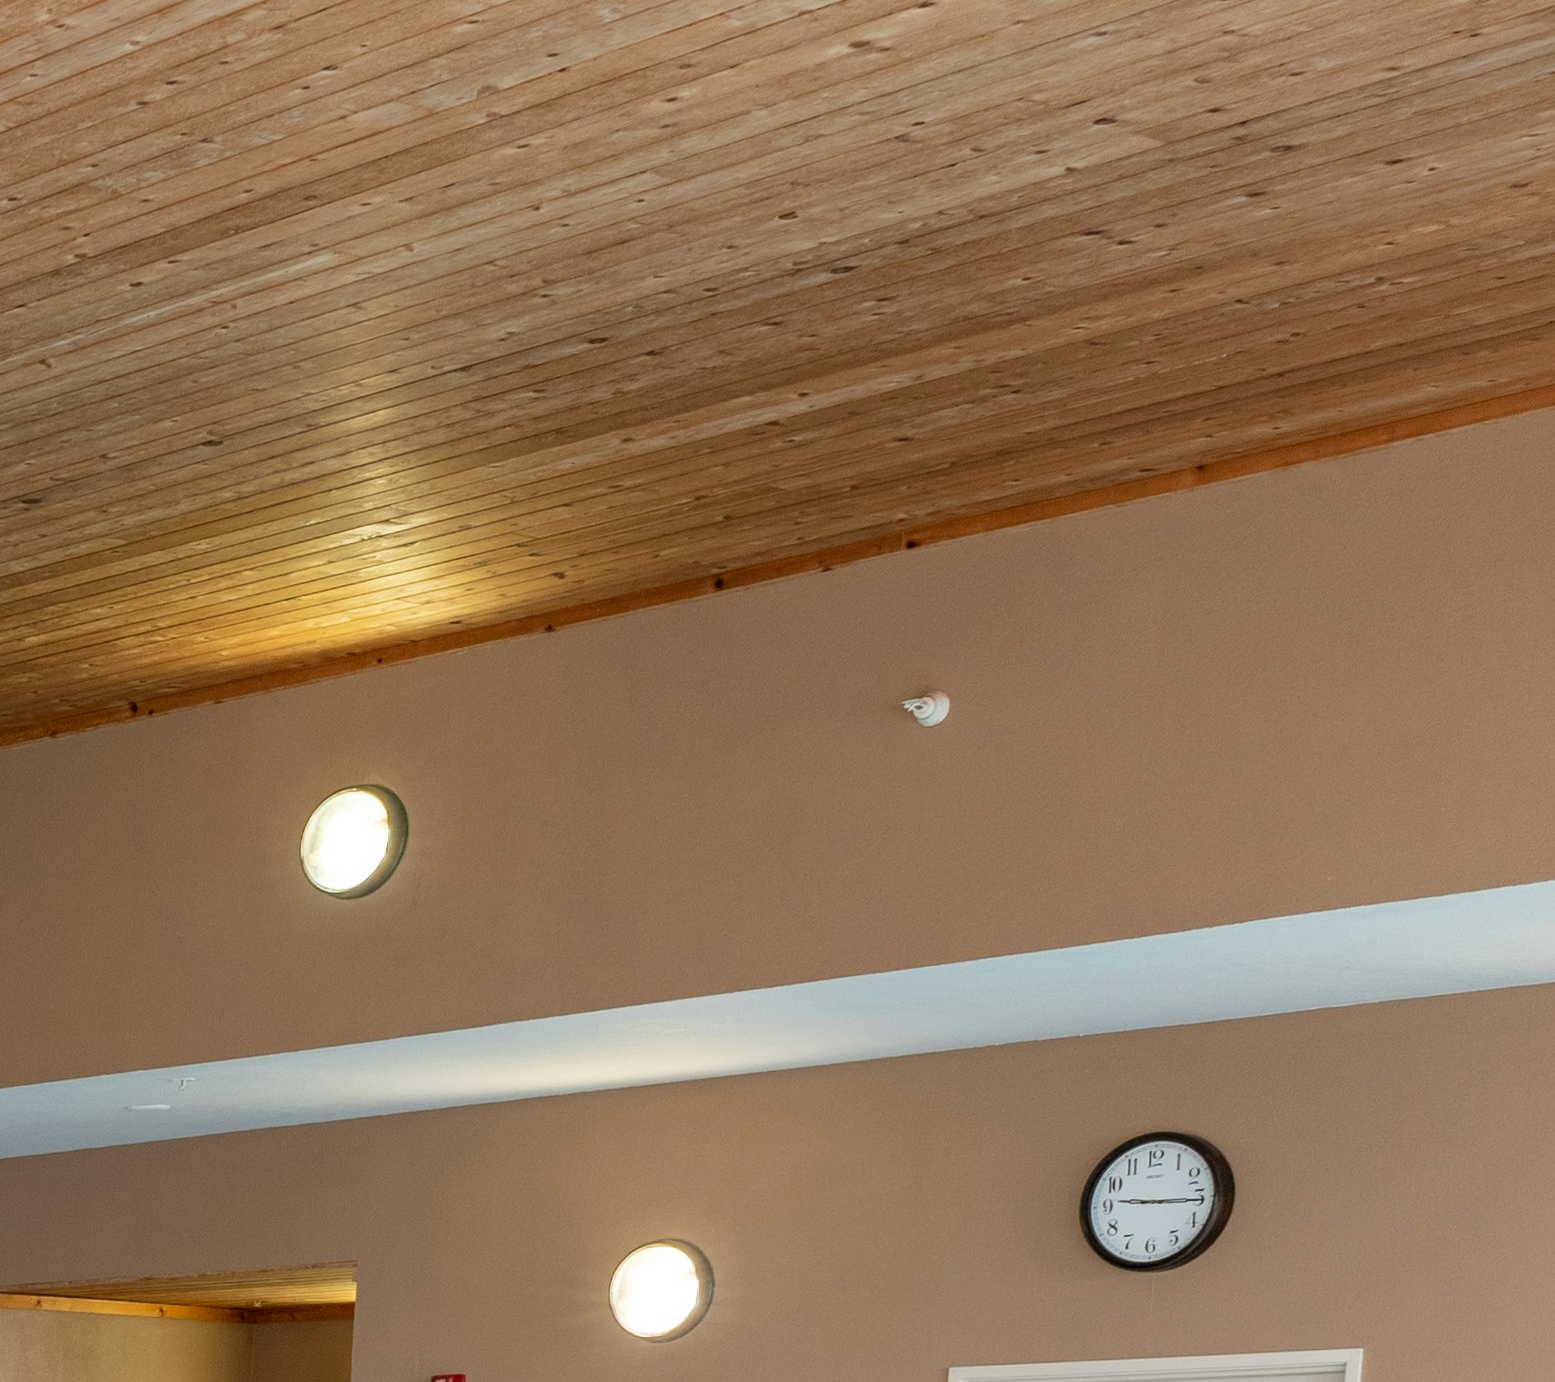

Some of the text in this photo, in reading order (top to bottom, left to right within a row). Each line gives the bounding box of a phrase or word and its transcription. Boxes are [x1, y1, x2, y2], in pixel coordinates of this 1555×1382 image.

[1126, 1158, 1138, 1176] 11
[1147, 1149, 1165, 1168] 12
[1175, 1153, 1182, 1171] 1
[1108, 1176, 1123, 1193] 10
[1187, 1167, 1201, 1185] 2
[1194, 1188, 1205, 1206] 3
[1102, 1198, 1113, 1215] 9
[1106, 1219, 1118, 1236] 8
[1184, 1211, 1199, 1228] 4
[1123, 1233, 1134, 1250] 7
[1144, 1237, 1156, 1254] 6
[1168, 1229, 1179, 1246] 5
